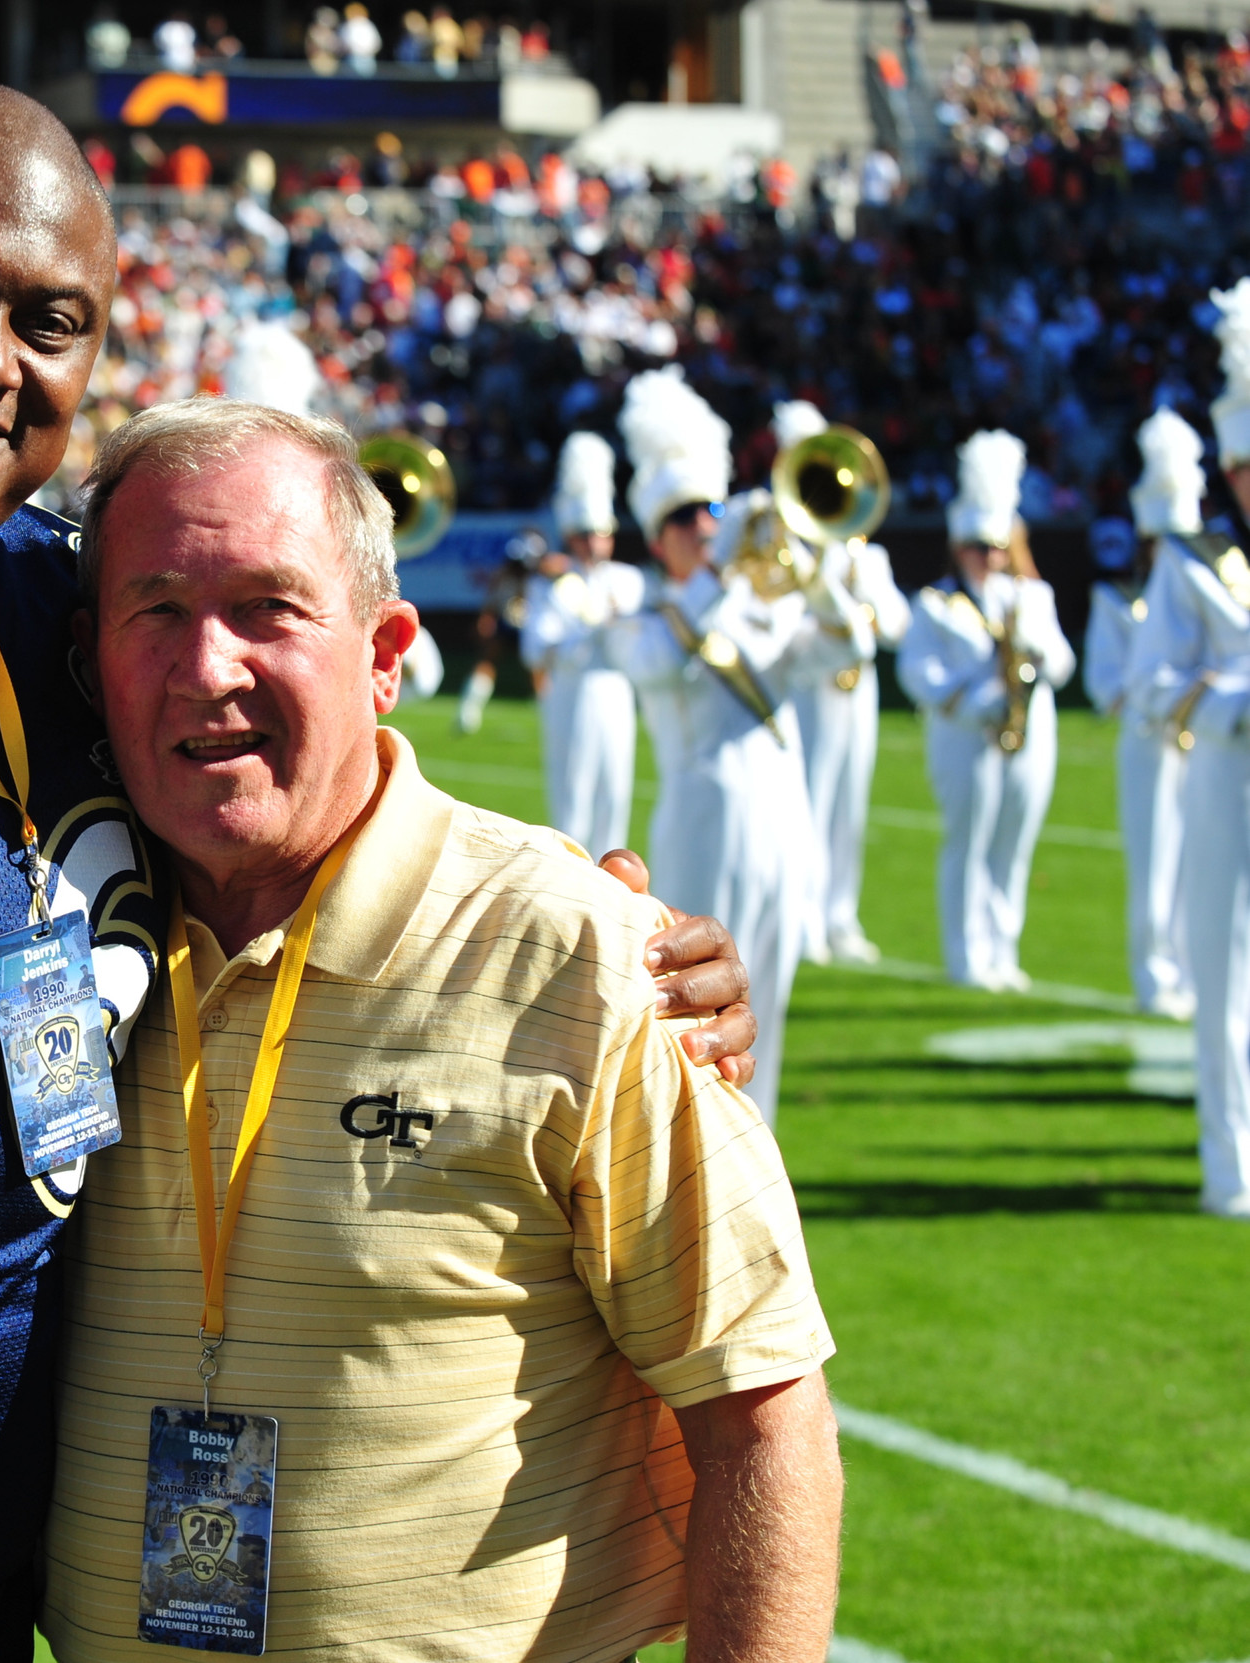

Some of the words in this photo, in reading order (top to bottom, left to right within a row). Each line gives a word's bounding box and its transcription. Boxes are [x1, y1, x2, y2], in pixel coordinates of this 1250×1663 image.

[23, 939, 61, 964] Darryl
[22, 957, 69, 982] Jenkins
[34, 981, 65, 1003] 1990
[10, 1005, 47, 1024] NATIONAL
[49, 987, 93, 1010] CHAMPIONS
[58, 1072, 72, 1084] GT
[46, 1111, 80, 1131] GEORGIA
[80, 1104, 99, 1118] TECH
[340, 1091, 434, 1148] GT
[33, 1136, 76, 1159] NOVEMBER
[99, 1118, 118, 1133] 2010
[39, 1125, 73, 1146] REUNION
[73, 1111, 109, 1132] WEEKEND
[188, 1430, 235, 1450] Bobby
[192, 1447, 229, 1463] Ross
[190, 1471, 230, 1488] 1990
[157, 1484, 202, 1497] NATIONAL
[204, 1489, 262, 1503] CHAMPIONS
[195, 1561, 214, 1575] GT
[156, 1609, 198, 1622] REUNION
[200, 1614, 247, 1627] WEEKEND
[168, 1600, 210, 1612] GEORGIA
[213, 1605, 236, 1615] TECH
[146, 1618, 199, 1632] NOVEMBER
[201, 1625, 229, 1637] 12-13,
[231, 1628, 255, 1639] 2010
